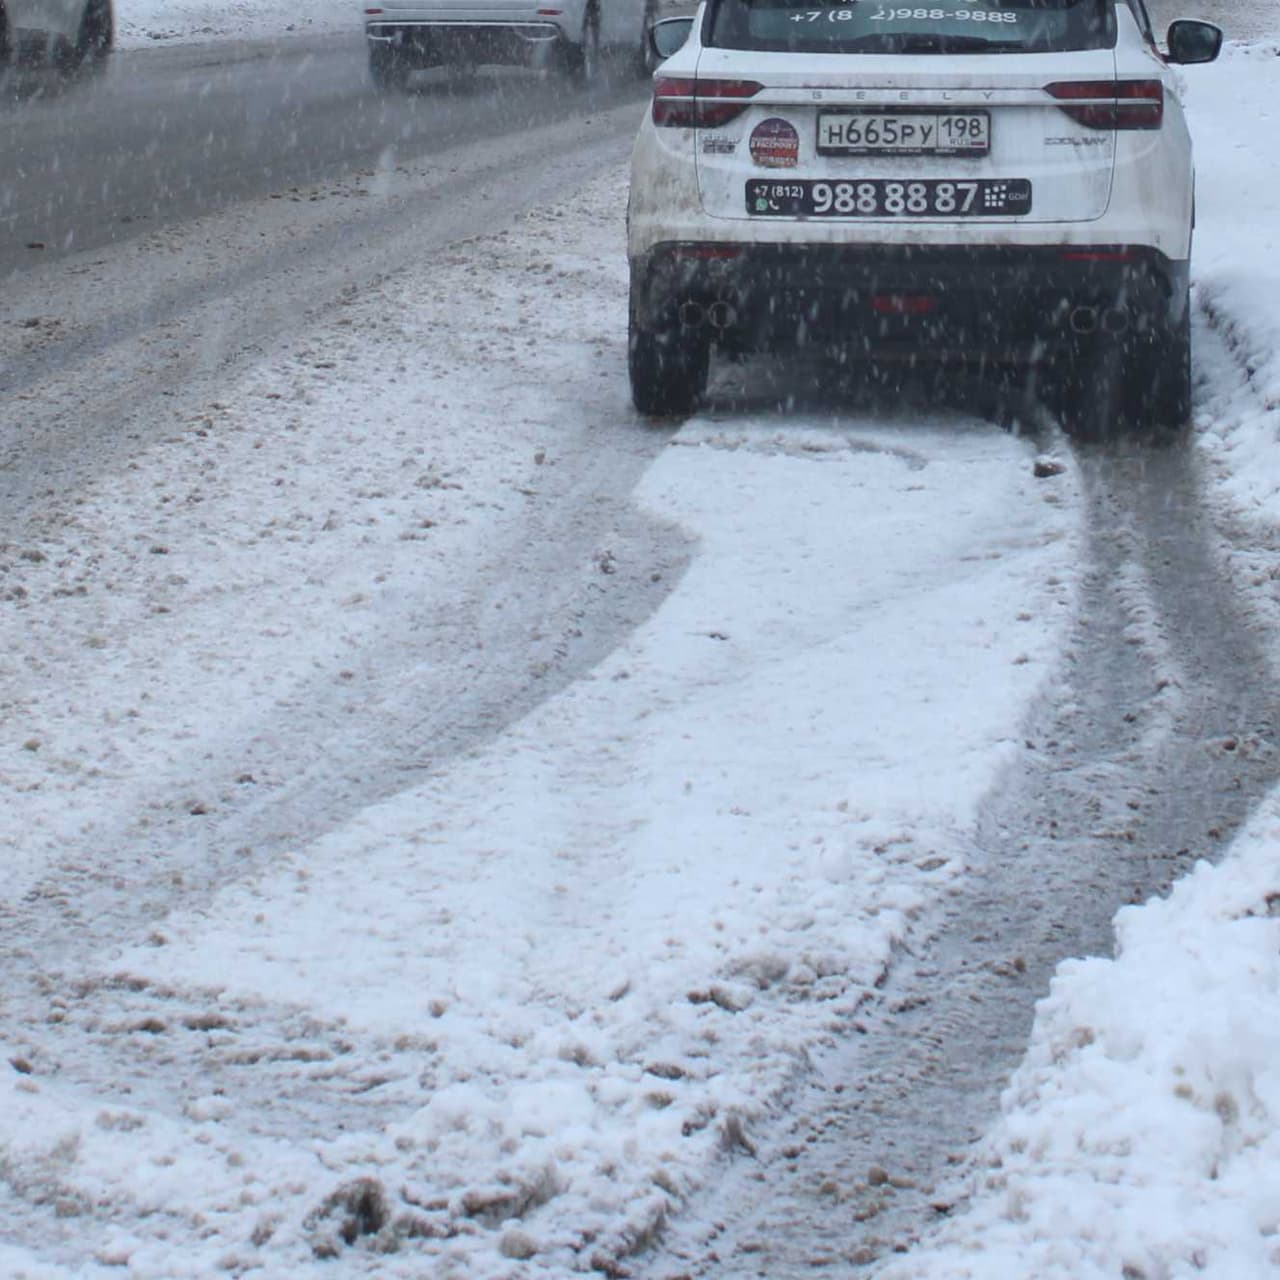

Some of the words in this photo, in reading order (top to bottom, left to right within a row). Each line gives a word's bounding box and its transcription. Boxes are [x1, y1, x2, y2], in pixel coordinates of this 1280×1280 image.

[789, 10, 822, 23] +7
[828, 8, 1017, 23] (82)988-9888
[812, 92, 993, 101] GEELY
[828, 119, 933, 145] Н665РУ
[941, 118, 982, 138] 198
[753, 186, 768, 196] +7
[771, 185, 804, 199] (812)
[811, 183, 877, 212] 988
[884, 183, 928, 212] 88
[935, 183, 978, 212] 87
